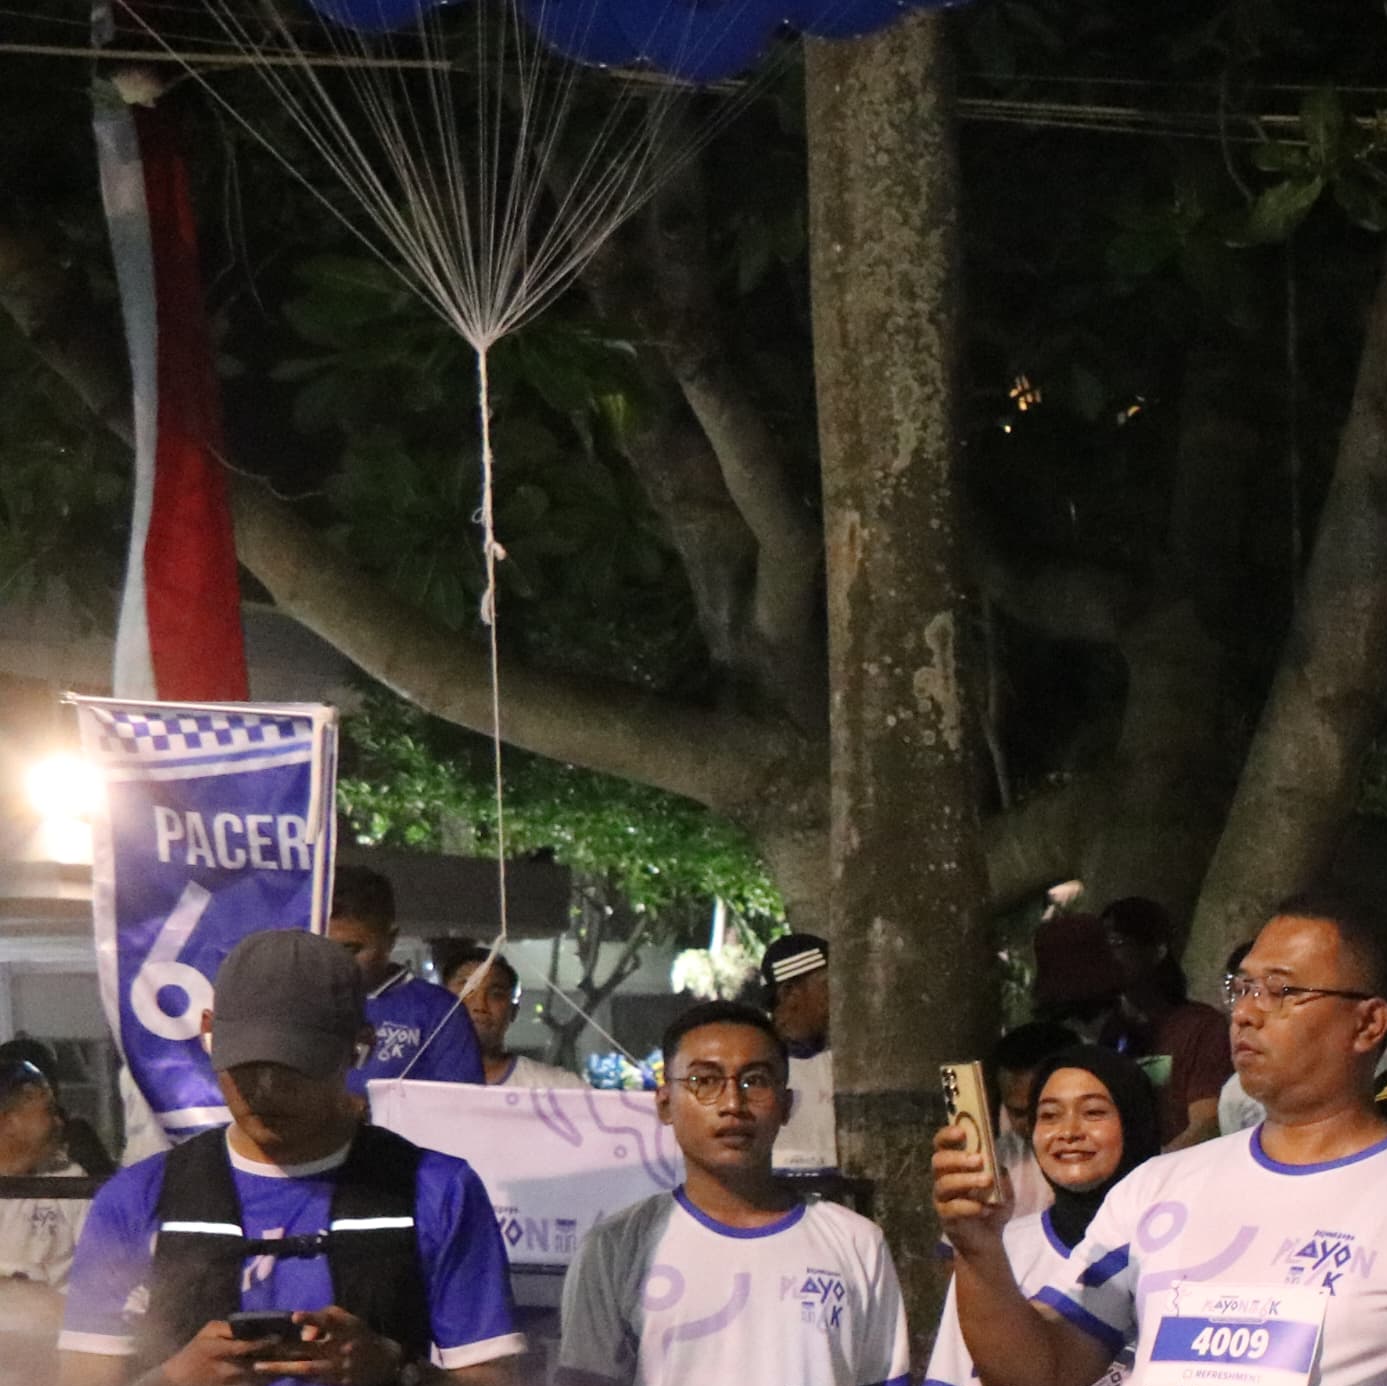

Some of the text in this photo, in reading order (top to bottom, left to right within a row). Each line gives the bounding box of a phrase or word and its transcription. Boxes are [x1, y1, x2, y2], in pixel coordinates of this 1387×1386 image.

[153, 805, 313, 871] PACER
[1190, 1326, 1270, 1360] 4009
[1195, 1370, 1262, 1384] REFRESHMENT
